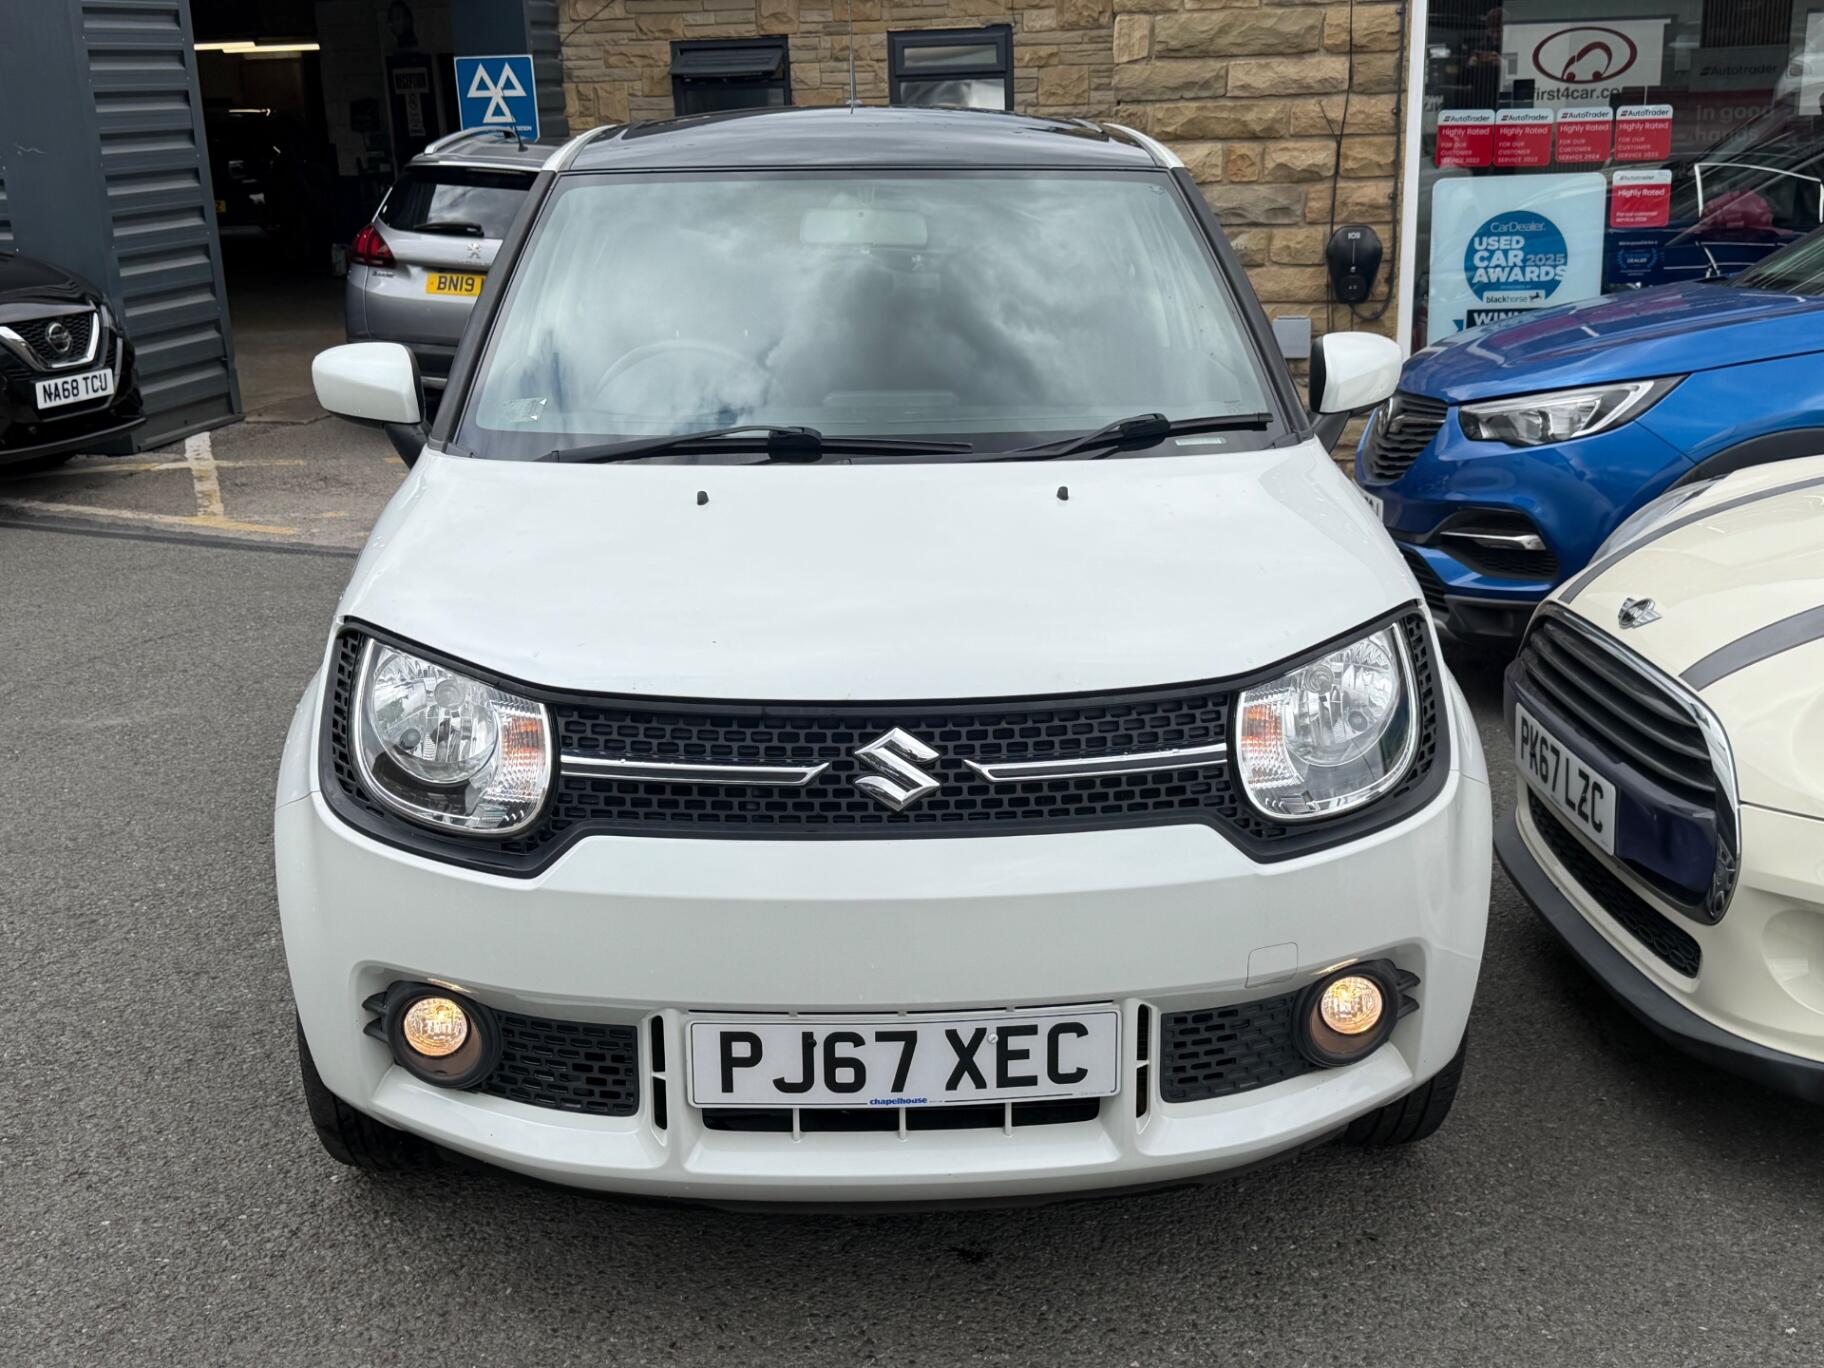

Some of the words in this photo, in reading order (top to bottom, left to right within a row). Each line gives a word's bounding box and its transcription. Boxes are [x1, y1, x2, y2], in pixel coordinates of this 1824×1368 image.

[1711, 64, 1777, 76] Autotrader
[1534, 86, 1621, 101] irst4car.co
[1568, 111, 1609, 119] AutoTrader
[1628, 109, 1669, 117] AutoTrader
[1442, 128, 1466, 136] Highly
[1467, 127, 1490, 135] Rated
[1499, 127, 1523, 136] Highly
[1560, 125, 1584, 134] Highly
[1585, 124, 1609, 132] Rated
[1619, 122, 1644, 132] Highly
[1645, 122, 1669, 130] Rated
[1617, 188, 1641, 198] Highly
[1642, 188, 1665, 197] Rated
[1474, 236, 1525, 250] USED
[1473, 250, 1524, 267] CAR
[1525, 254, 1565, 266] 2025
[1471, 265, 1568, 283] AWARDS
[436, 275, 475, 292] BN19
[1486, 295, 1528, 304] blackhorse
[42, 379, 80, 404] NA68
[82, 373, 108, 395] TCU
[1520, 716, 1560, 793] PK67
[1565, 758, 1604, 834] LZC
[720, 1030, 918, 1094] PJ67
[945, 1022, 1089, 1091] XEC
[869, 1096, 928, 1105] chapelhouse
